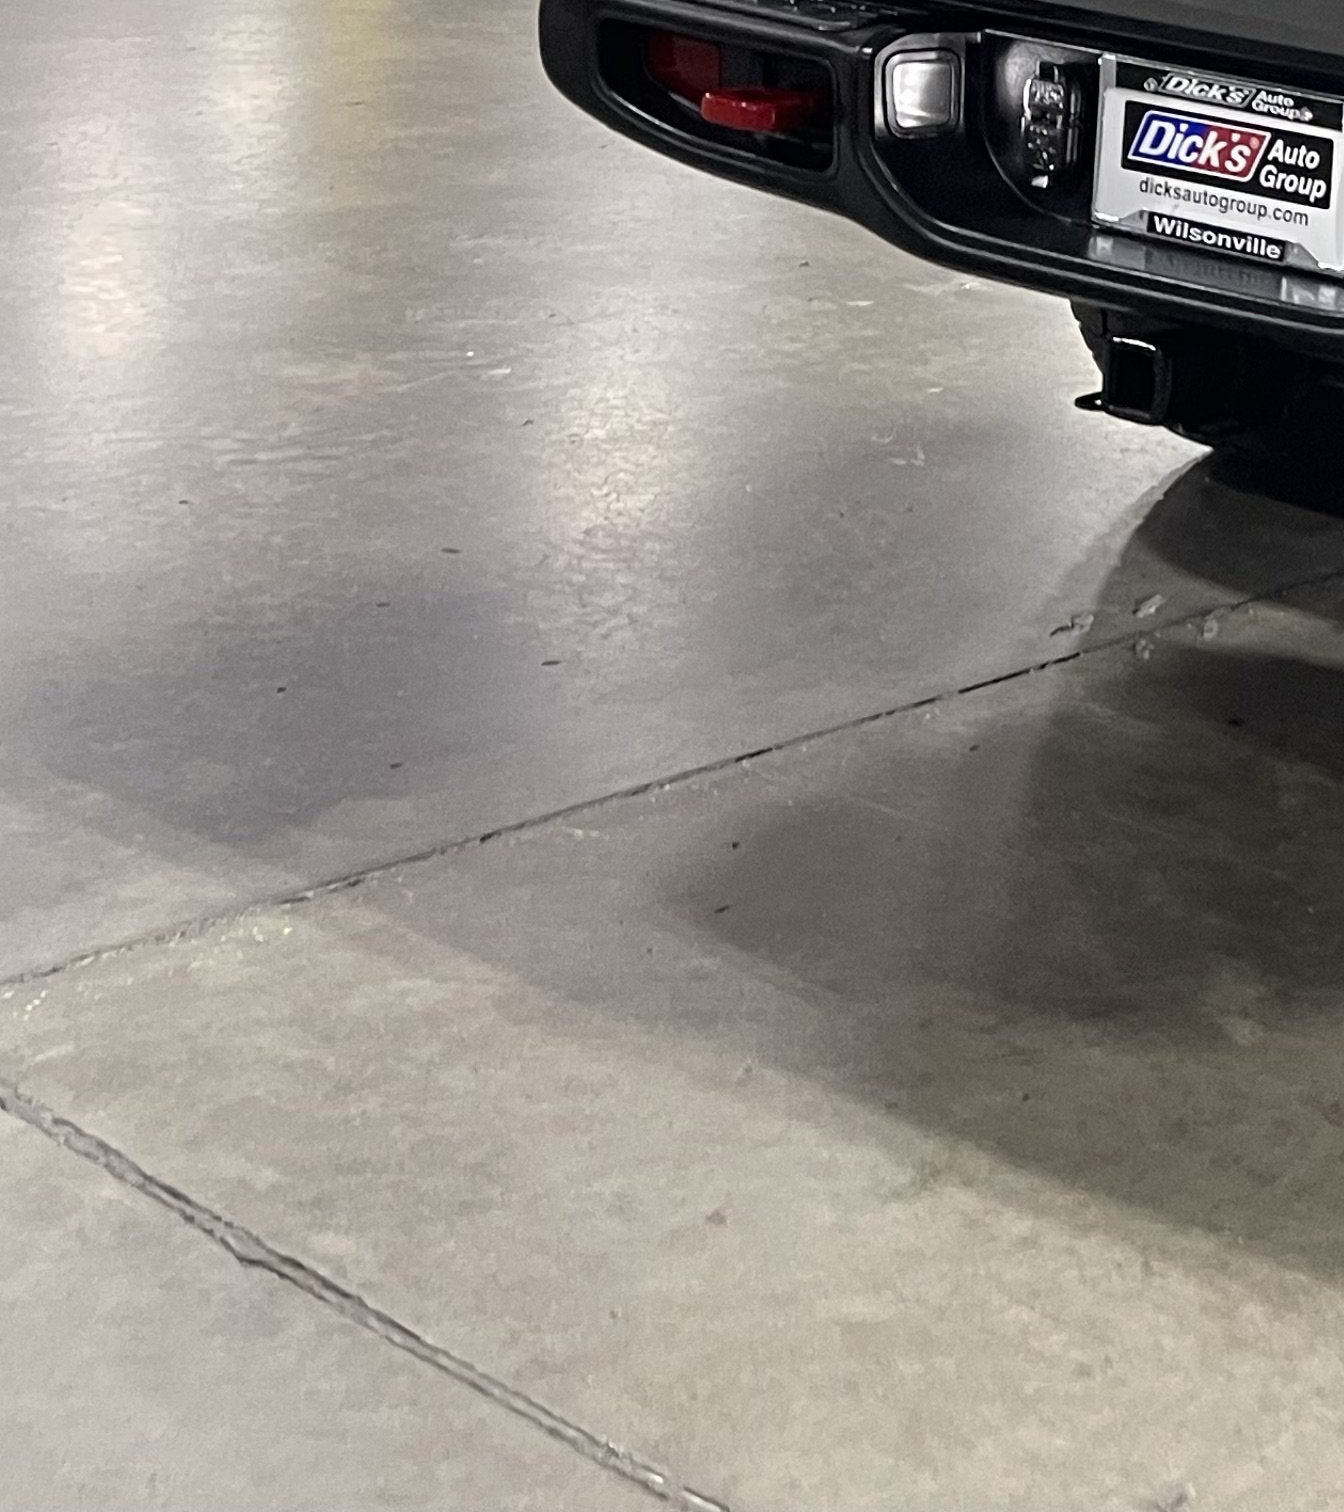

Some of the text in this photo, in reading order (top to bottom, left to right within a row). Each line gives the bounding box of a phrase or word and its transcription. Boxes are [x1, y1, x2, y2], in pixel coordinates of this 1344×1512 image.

[1251, 99, 1302, 120] Group
[1255, 90, 1295, 108] Auto
[1138, 119, 1252, 173] Dick's
[1267, 139, 1320, 170] Auto
[1138, 176, 1309, 226] dicksautogroup.com
[1258, 164, 1327, 202] Group
[1153, 214, 1282, 259] Wilsonville
